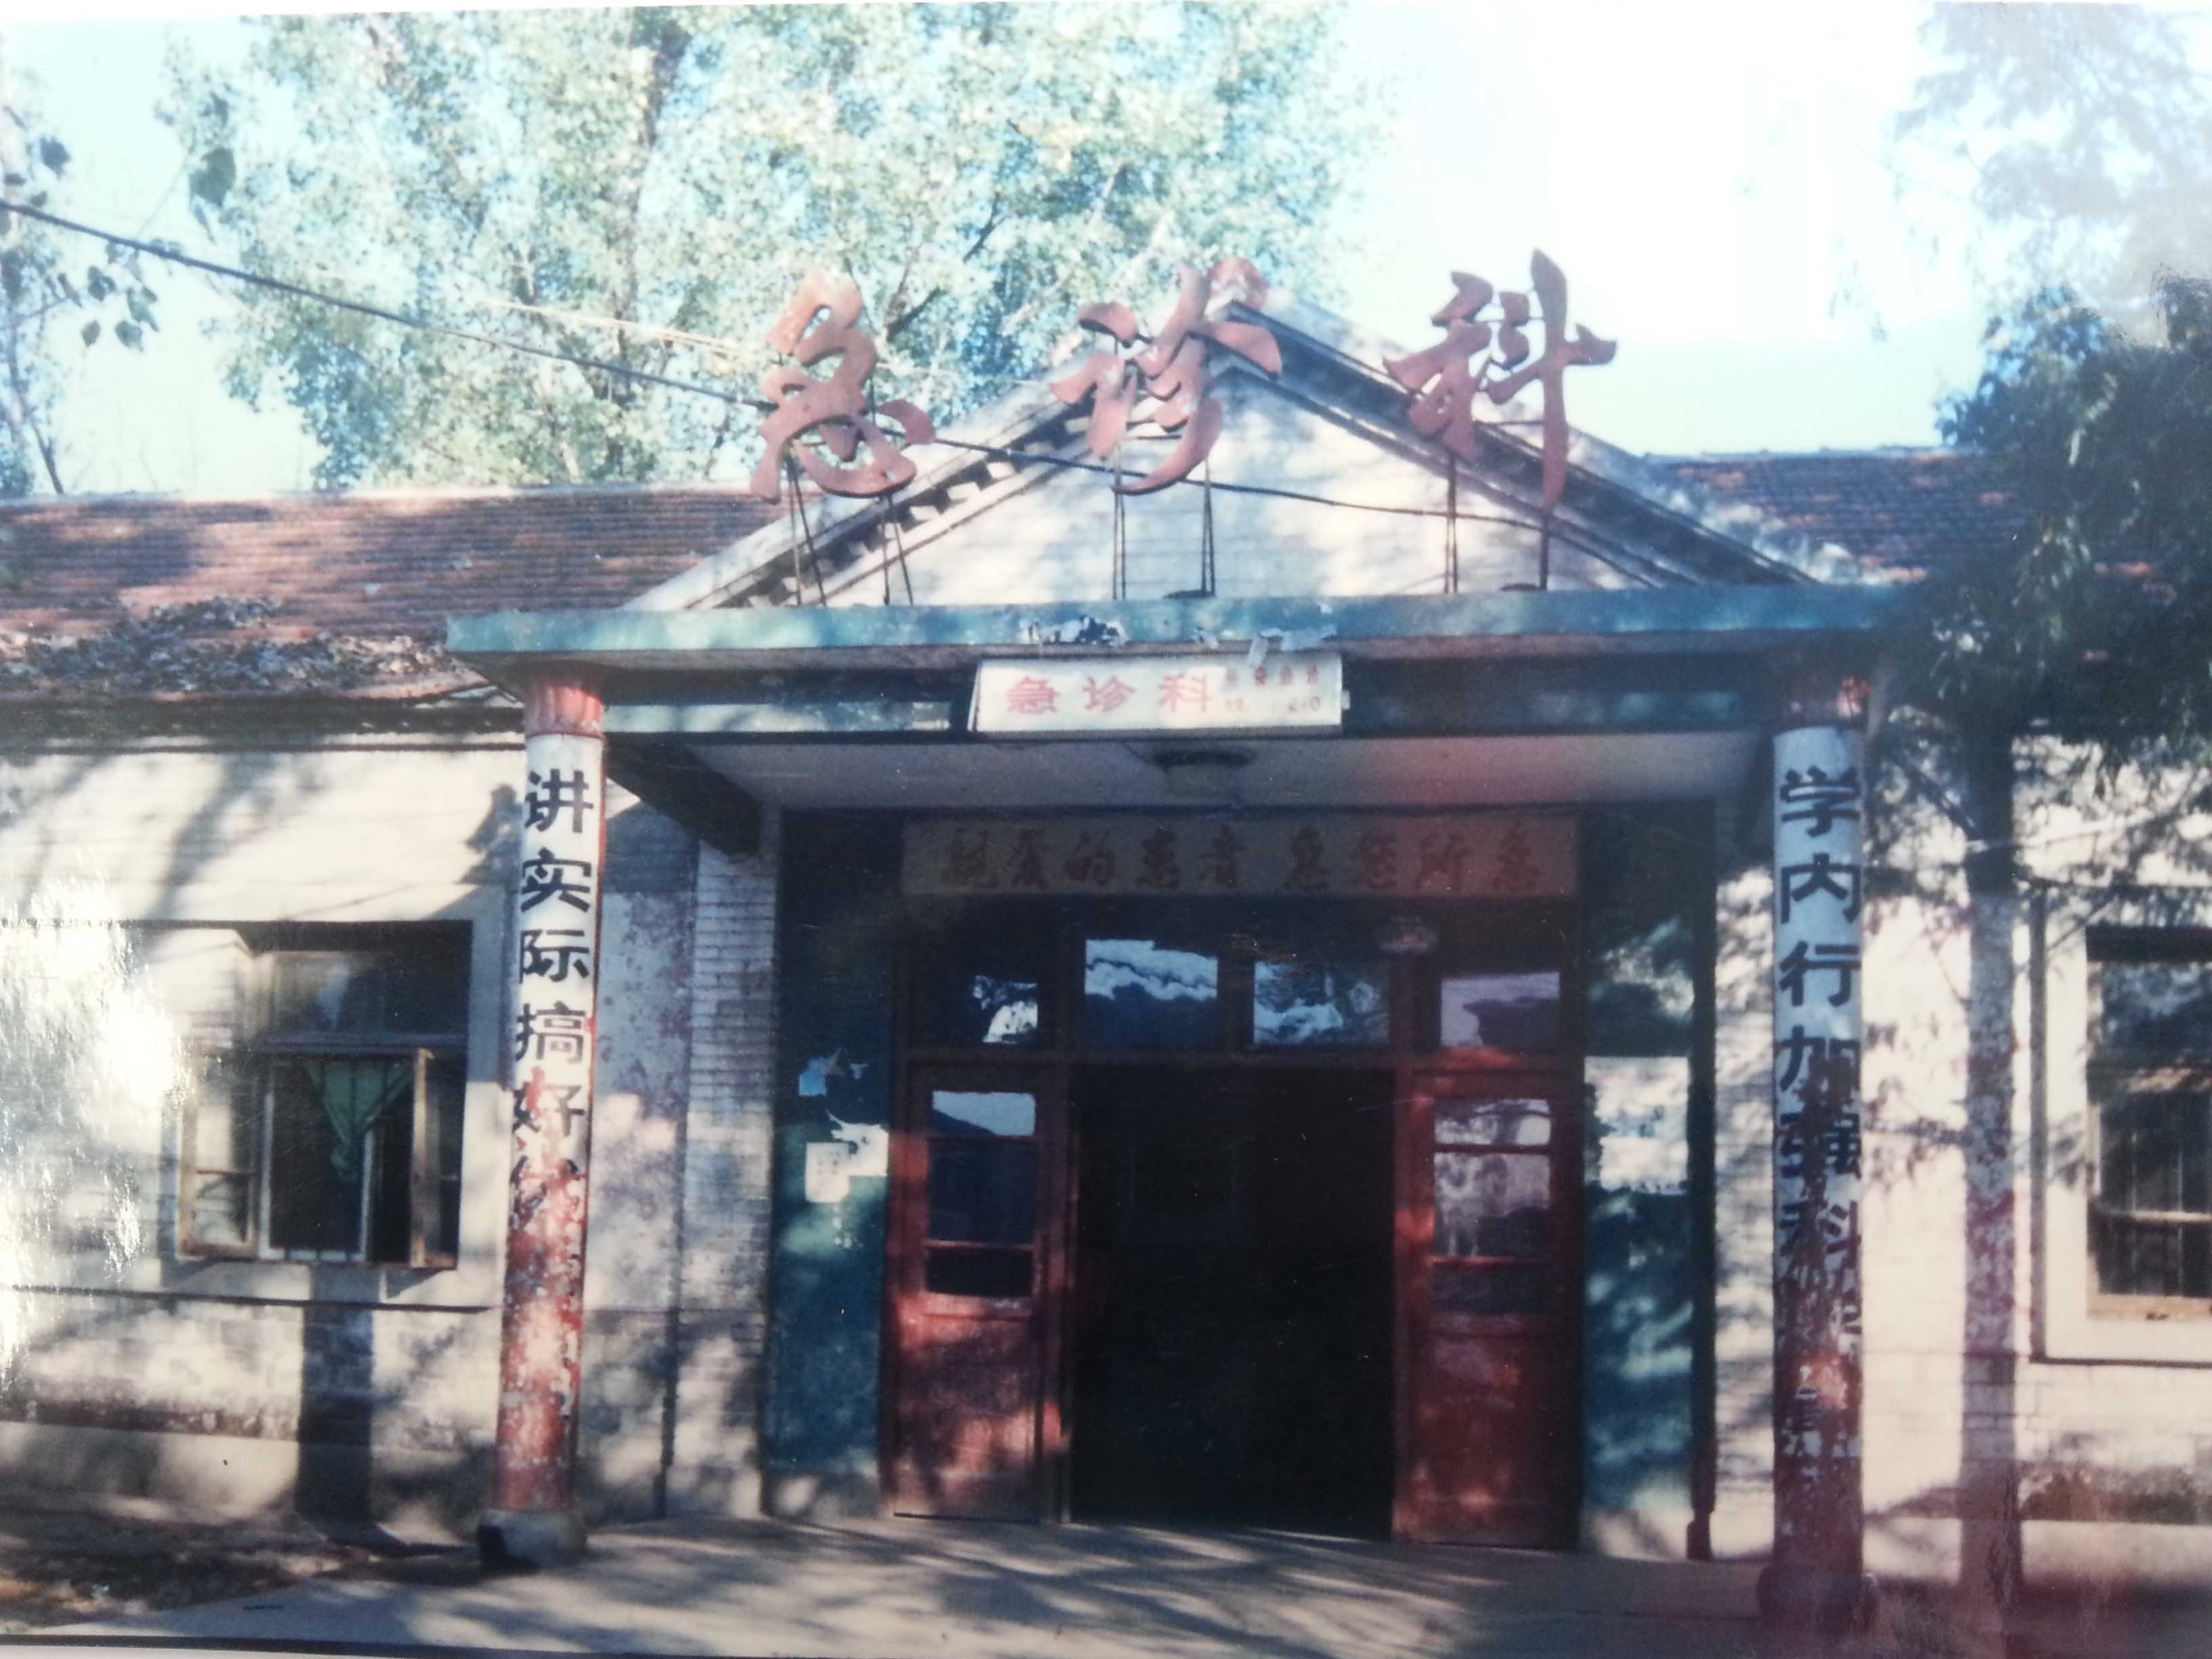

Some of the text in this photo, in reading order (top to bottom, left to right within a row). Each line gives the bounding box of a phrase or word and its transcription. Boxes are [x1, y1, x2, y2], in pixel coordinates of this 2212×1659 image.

[750, 248, 1618, 510] 急诊科
[1007, 672, 1212, 715] 急诊科
